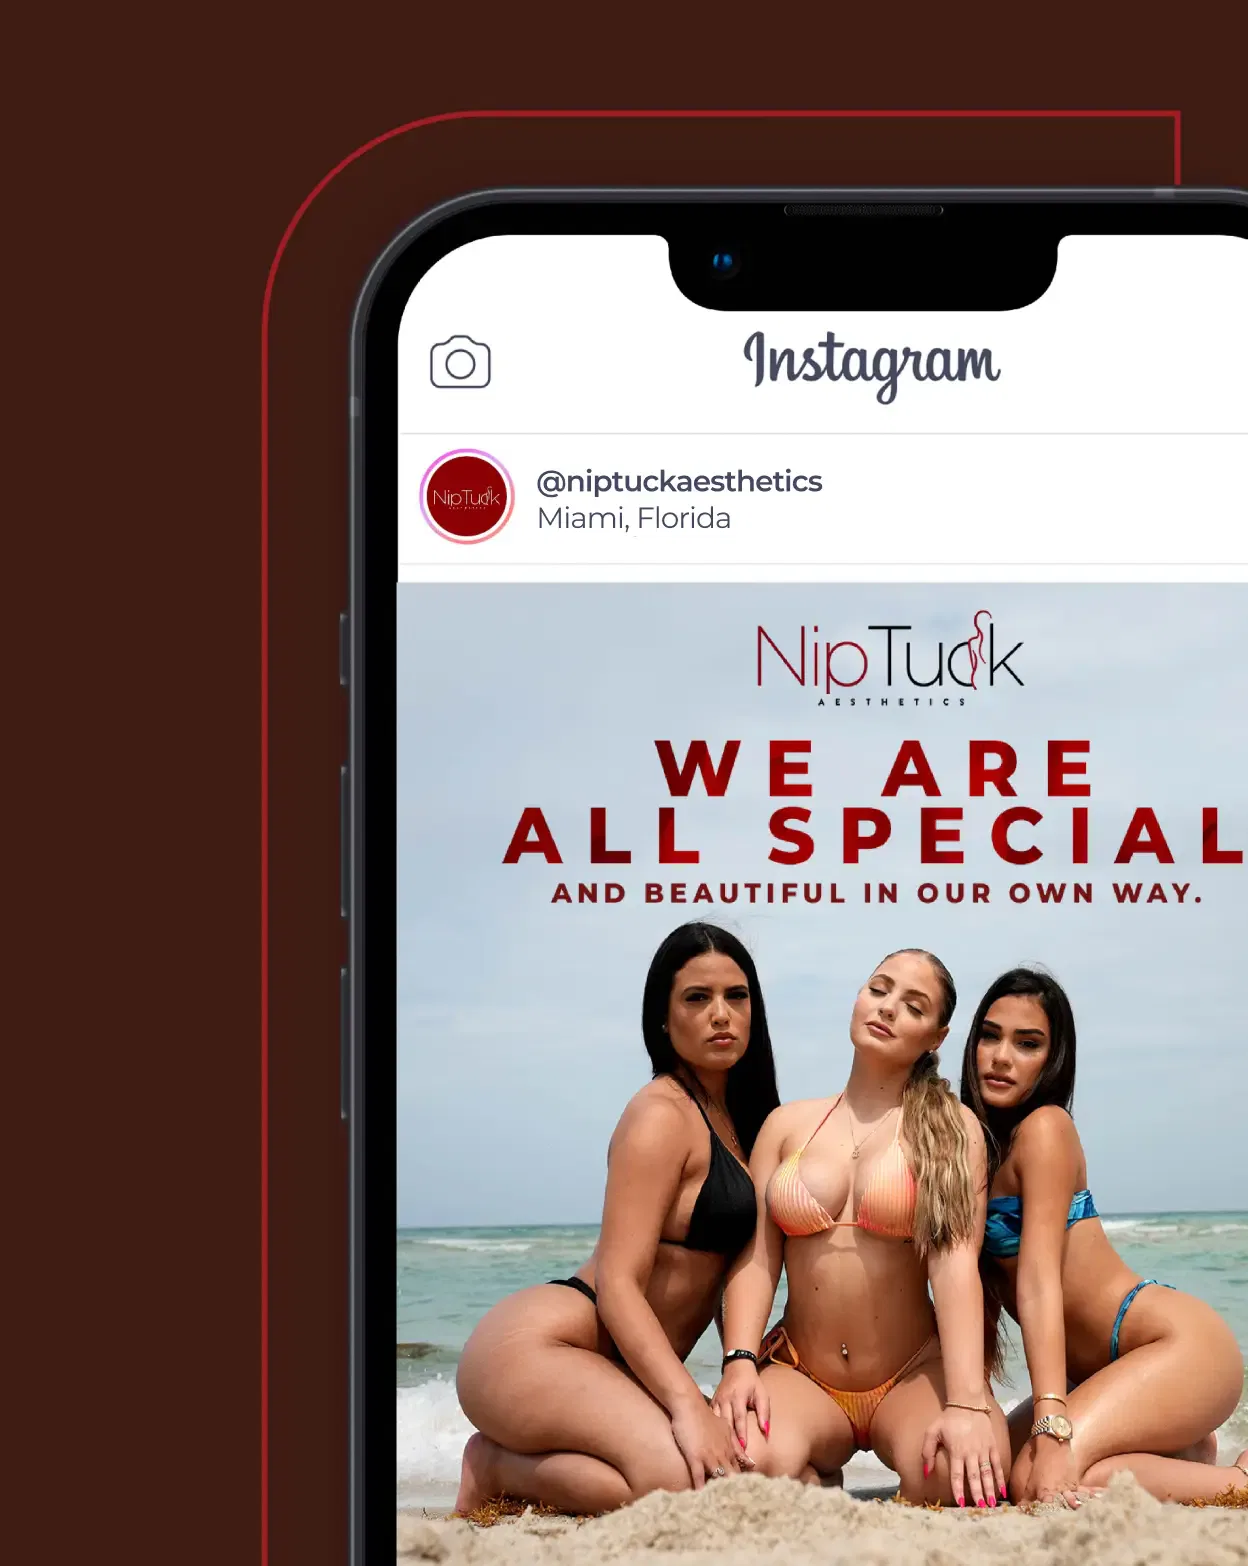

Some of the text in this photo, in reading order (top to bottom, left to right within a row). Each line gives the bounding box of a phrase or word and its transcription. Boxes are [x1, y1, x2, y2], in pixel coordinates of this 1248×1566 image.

[743, 330, 1002, 406] Instagram
[536, 468, 823, 498] @niptuckaesthetics
[538, 505, 731, 533] Miami, Florida
[757, 610, 1025, 695] NipTuck
[817, 697, 965, 707] AESTHETICS
[654, 739, 1091, 797] WE ARE
[502, 806, 1244, 866] ALL SPECIAL
[550, 882, 1202, 905] AND BEAUTIFUL IN OUR OWN WAY.
